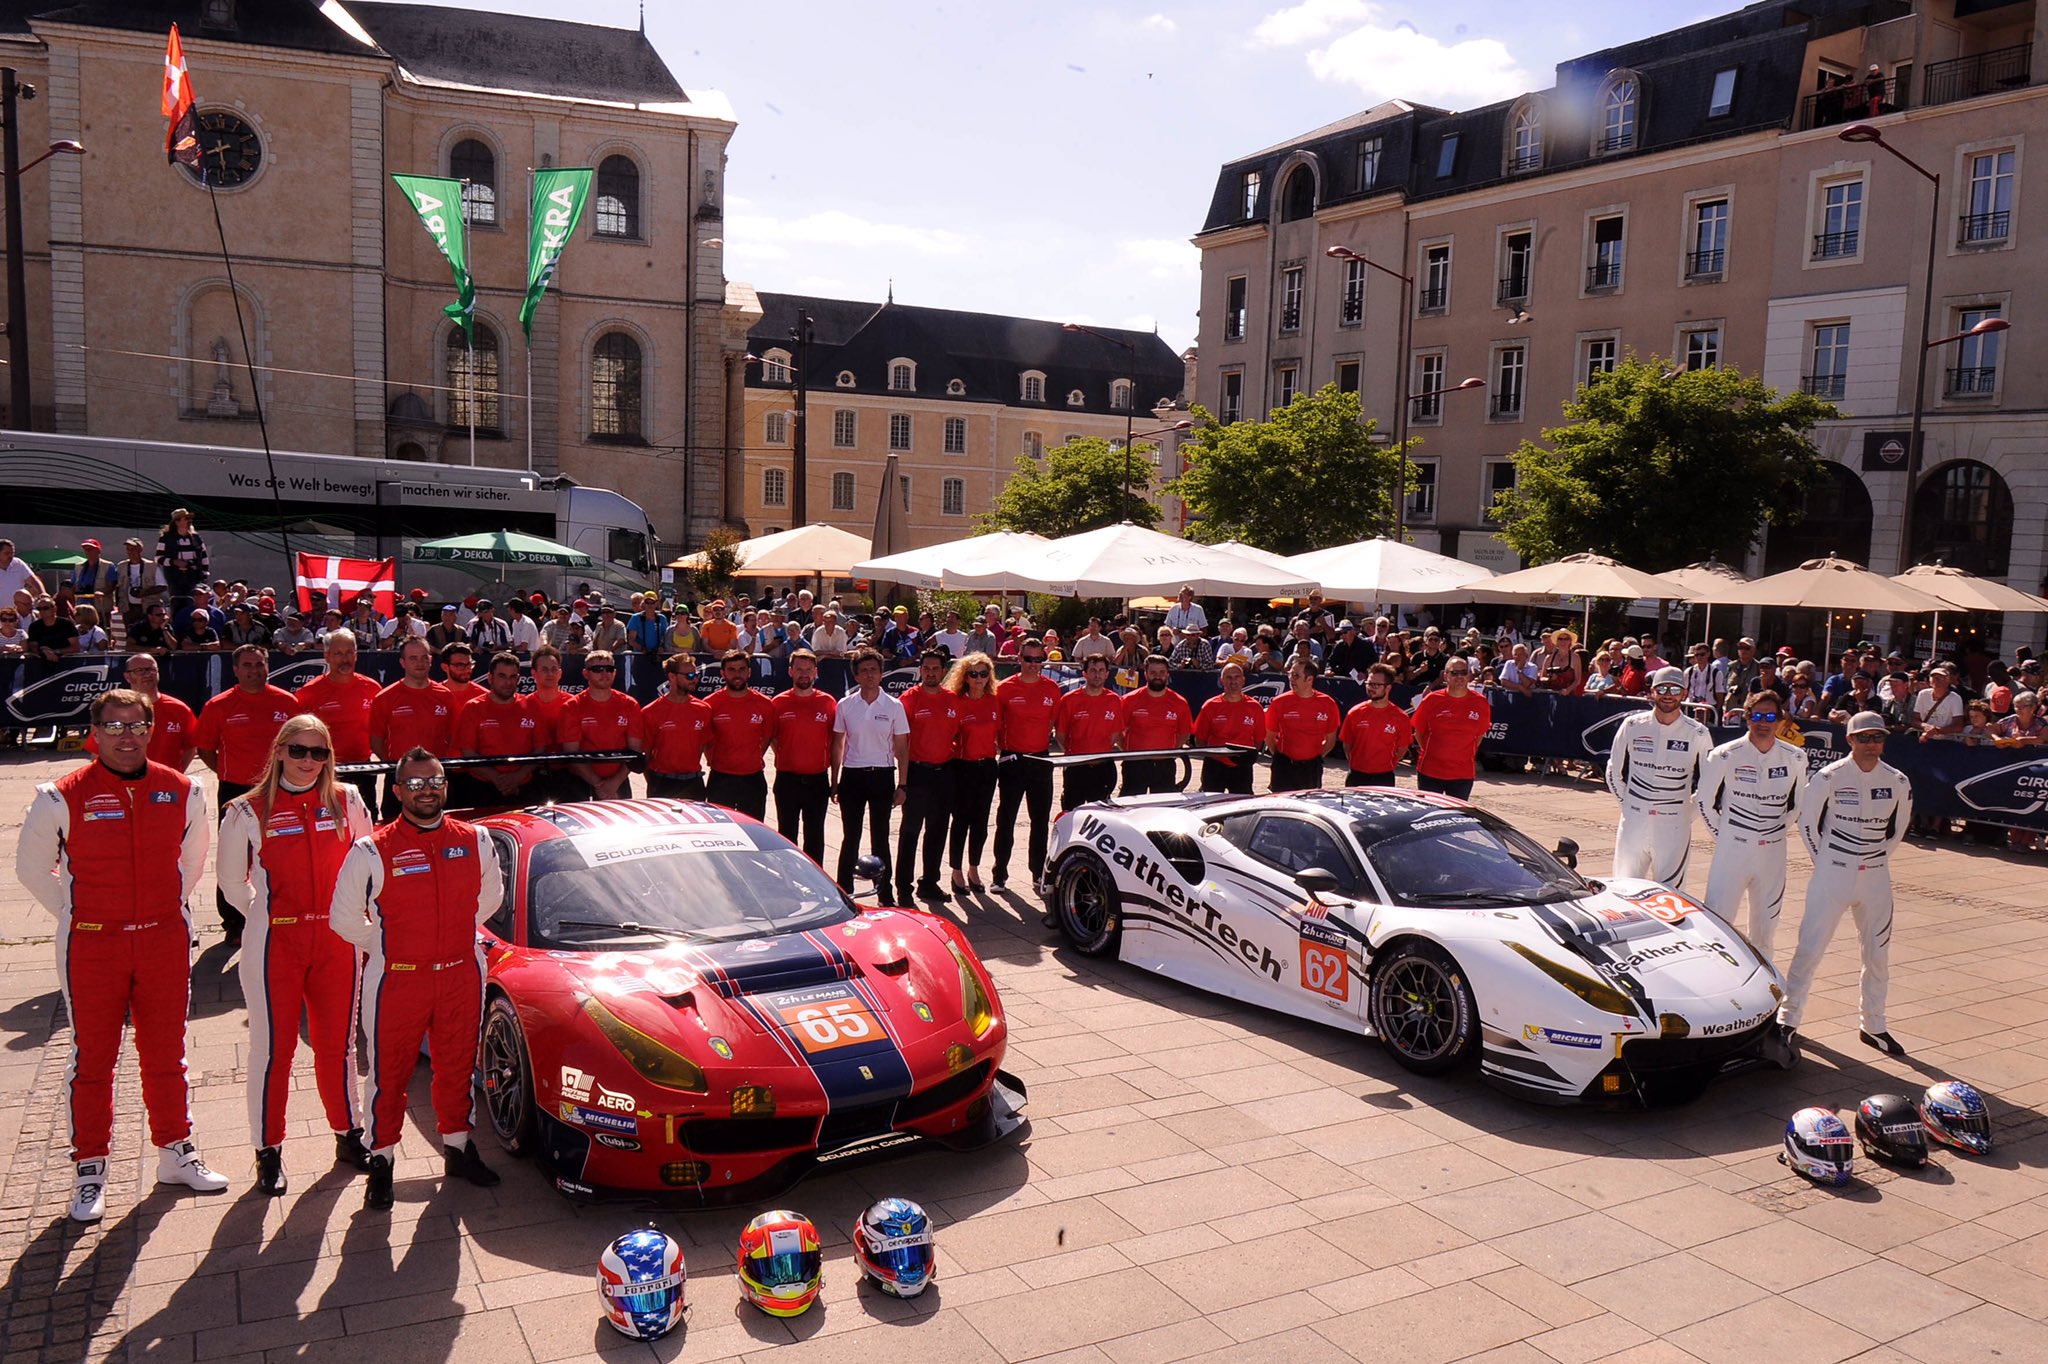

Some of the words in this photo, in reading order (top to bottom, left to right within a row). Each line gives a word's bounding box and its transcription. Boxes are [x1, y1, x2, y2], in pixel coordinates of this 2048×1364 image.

[537, 185, 574, 287] DEKRA
[229, 473, 261, 488] Was
[265, 474, 285, 488] de
[289, 477, 320, 492] Welt
[324, 478, 376, 497] bewegt,
[402, 484, 450, 497] machen
[453, 486, 473, 498] wir
[475, 487, 511, 501] sicher.
[464, 549, 494, 560] DEKRA
[529, 553, 558, 563] DEKRA
[64, 681, 122, 693] CIRCUIT
[2013, 790, 2034, 798] DES
[594, 843, 682, 861] SCUDERIA
[690, 840, 747, 848] CORSA
[1643, 894, 1698, 919] 62
[1316, 931, 1325, 939] LE
[1306, 948, 1343, 996] 62
[816, 989, 847, 999] MANS
[1458, 990, 1468, 1035] MICHELIN
[797, 1003, 870, 1043] 65
[1551, 1032, 1601, 1045] MICHELIN
[561, 1091, 590, 1102] RACING
[597, 1095, 635, 1112] AERO
[585, 1113, 635, 1128] MICHELIN
[816, 1145, 880, 1162] SCUDERIA
[879, 1134, 922, 1147] CORSA
[624, 1277, 673, 1295] Ferrari
